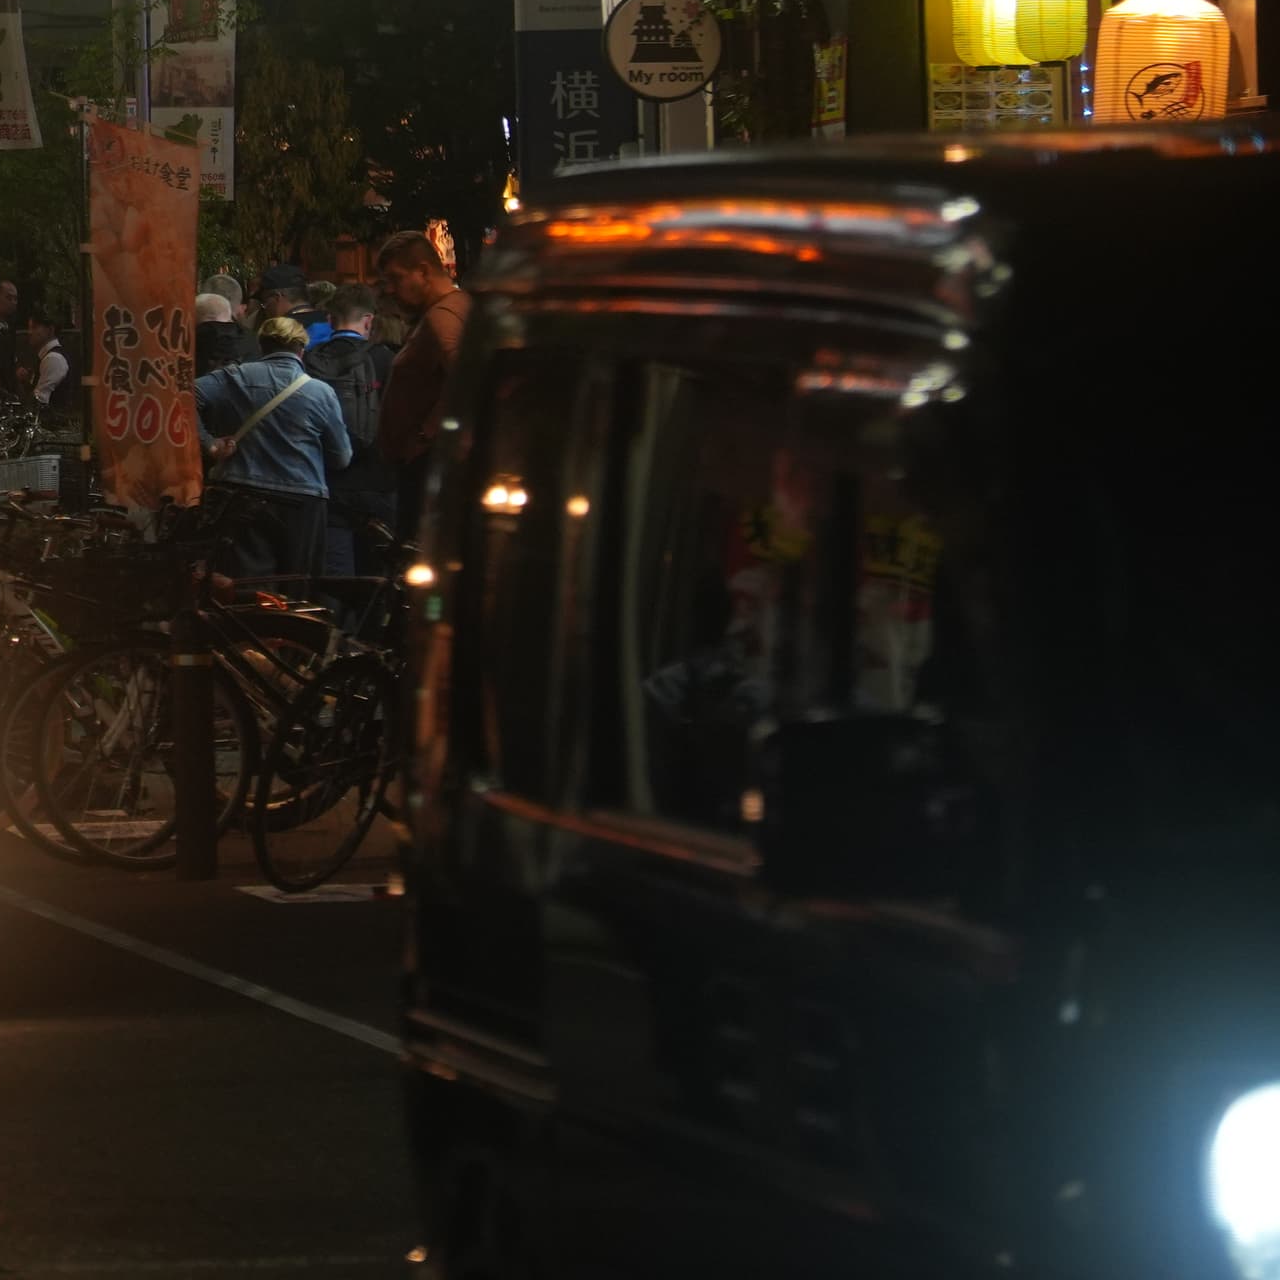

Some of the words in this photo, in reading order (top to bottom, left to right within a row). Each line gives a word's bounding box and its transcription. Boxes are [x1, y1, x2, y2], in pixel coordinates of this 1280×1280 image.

[628, 69, 654, 85] My
[658, 71, 705, 82] room
[549, 70, 601, 162] 横浜
